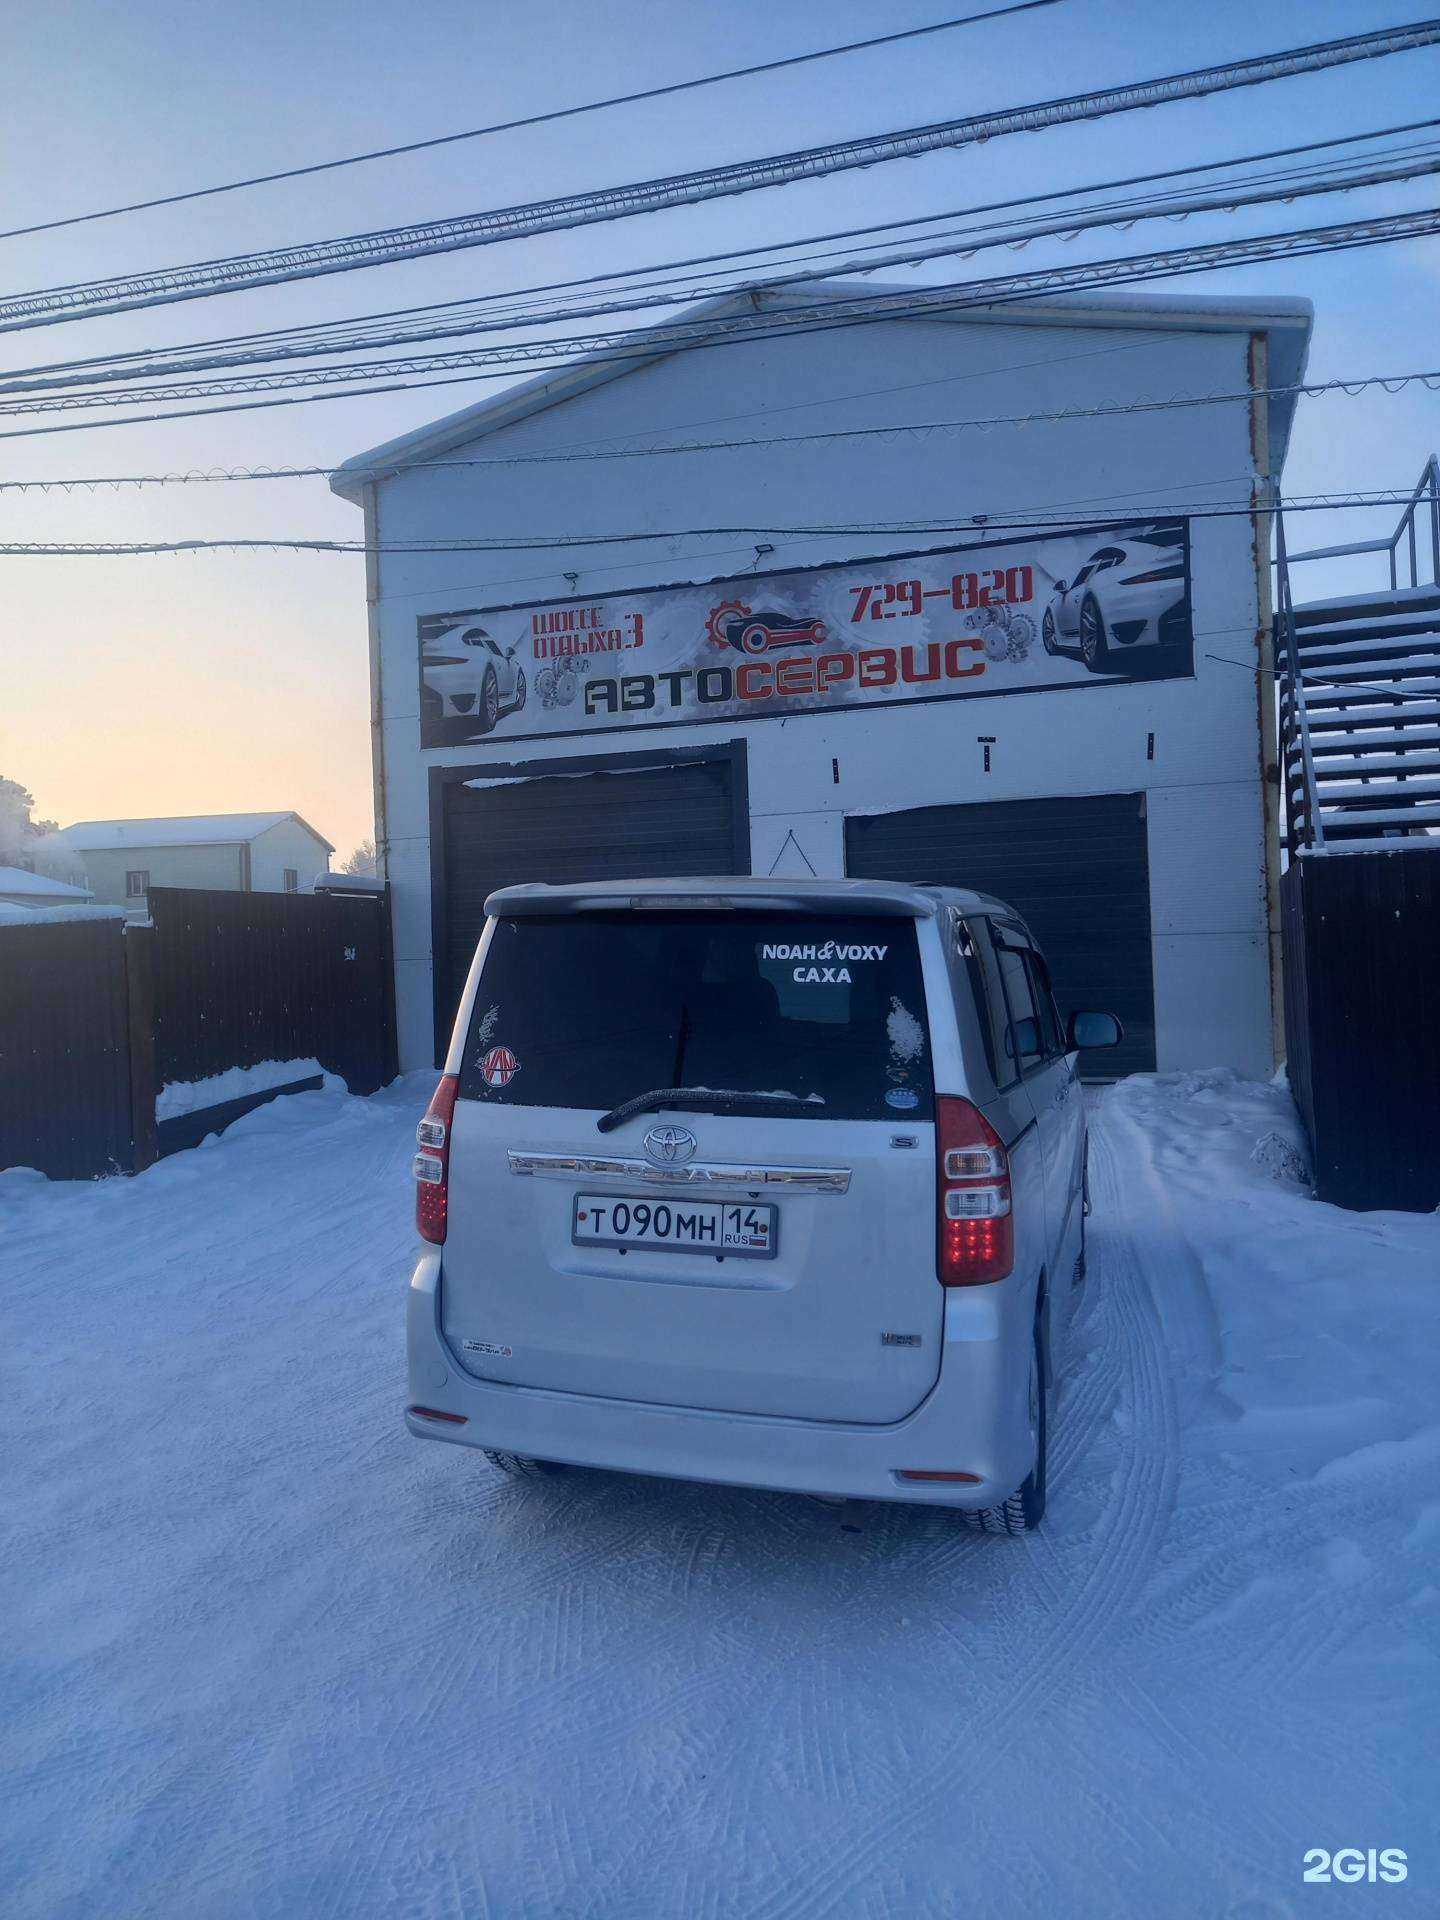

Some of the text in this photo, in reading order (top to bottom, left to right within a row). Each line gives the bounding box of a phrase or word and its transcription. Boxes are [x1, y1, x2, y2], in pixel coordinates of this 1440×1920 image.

[848, 565, 1034, 623] 729-820
[532, 606, 604, 635] ШОССЕ
[533, 613, 644, 659] ОТДЫХА 3
[584, 638, 987, 715] АВТОСЕРВИС
[793, 967, 852, 984] САХА
[728, 1208, 759, 1235] 14
[724, 1234, 748, 1246] RUS
